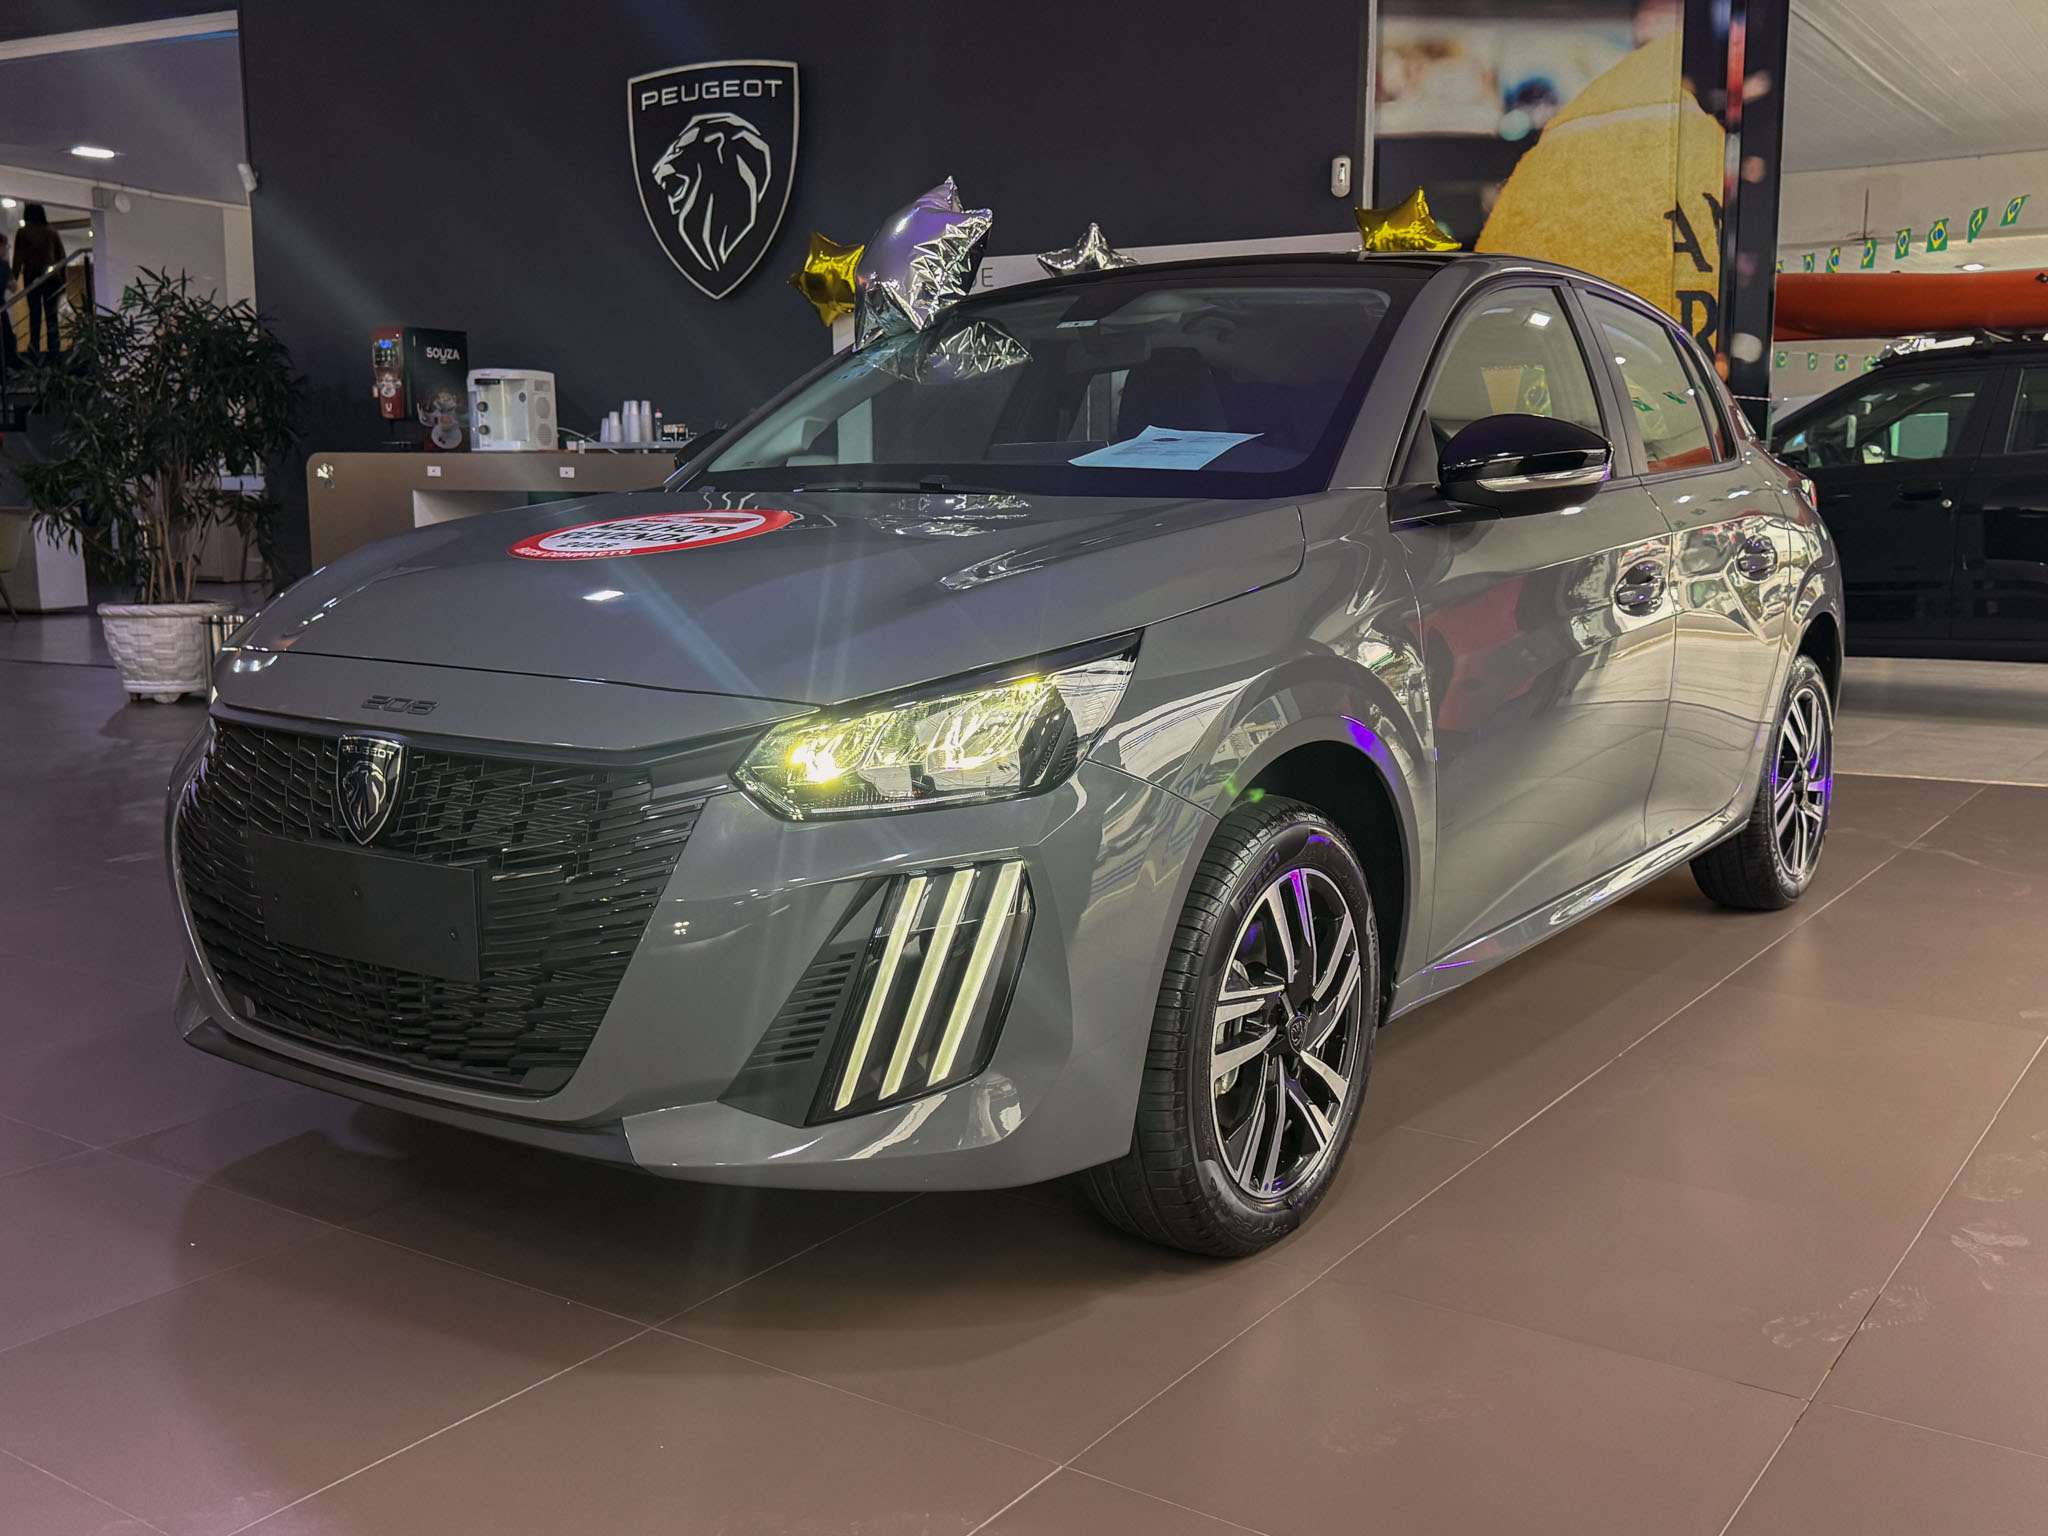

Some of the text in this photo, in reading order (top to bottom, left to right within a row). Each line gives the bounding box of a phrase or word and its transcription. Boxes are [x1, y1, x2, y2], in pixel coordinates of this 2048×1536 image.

[641, 79, 783, 111] PEUGEOT
[426, 346, 460, 361] SOUZA
[587, 522, 737, 535] MELHOR
[552, 531, 699, 543] REVENDA
[361, 694, 441, 716] 208
[342, 744, 396, 760] PEUGEOT
